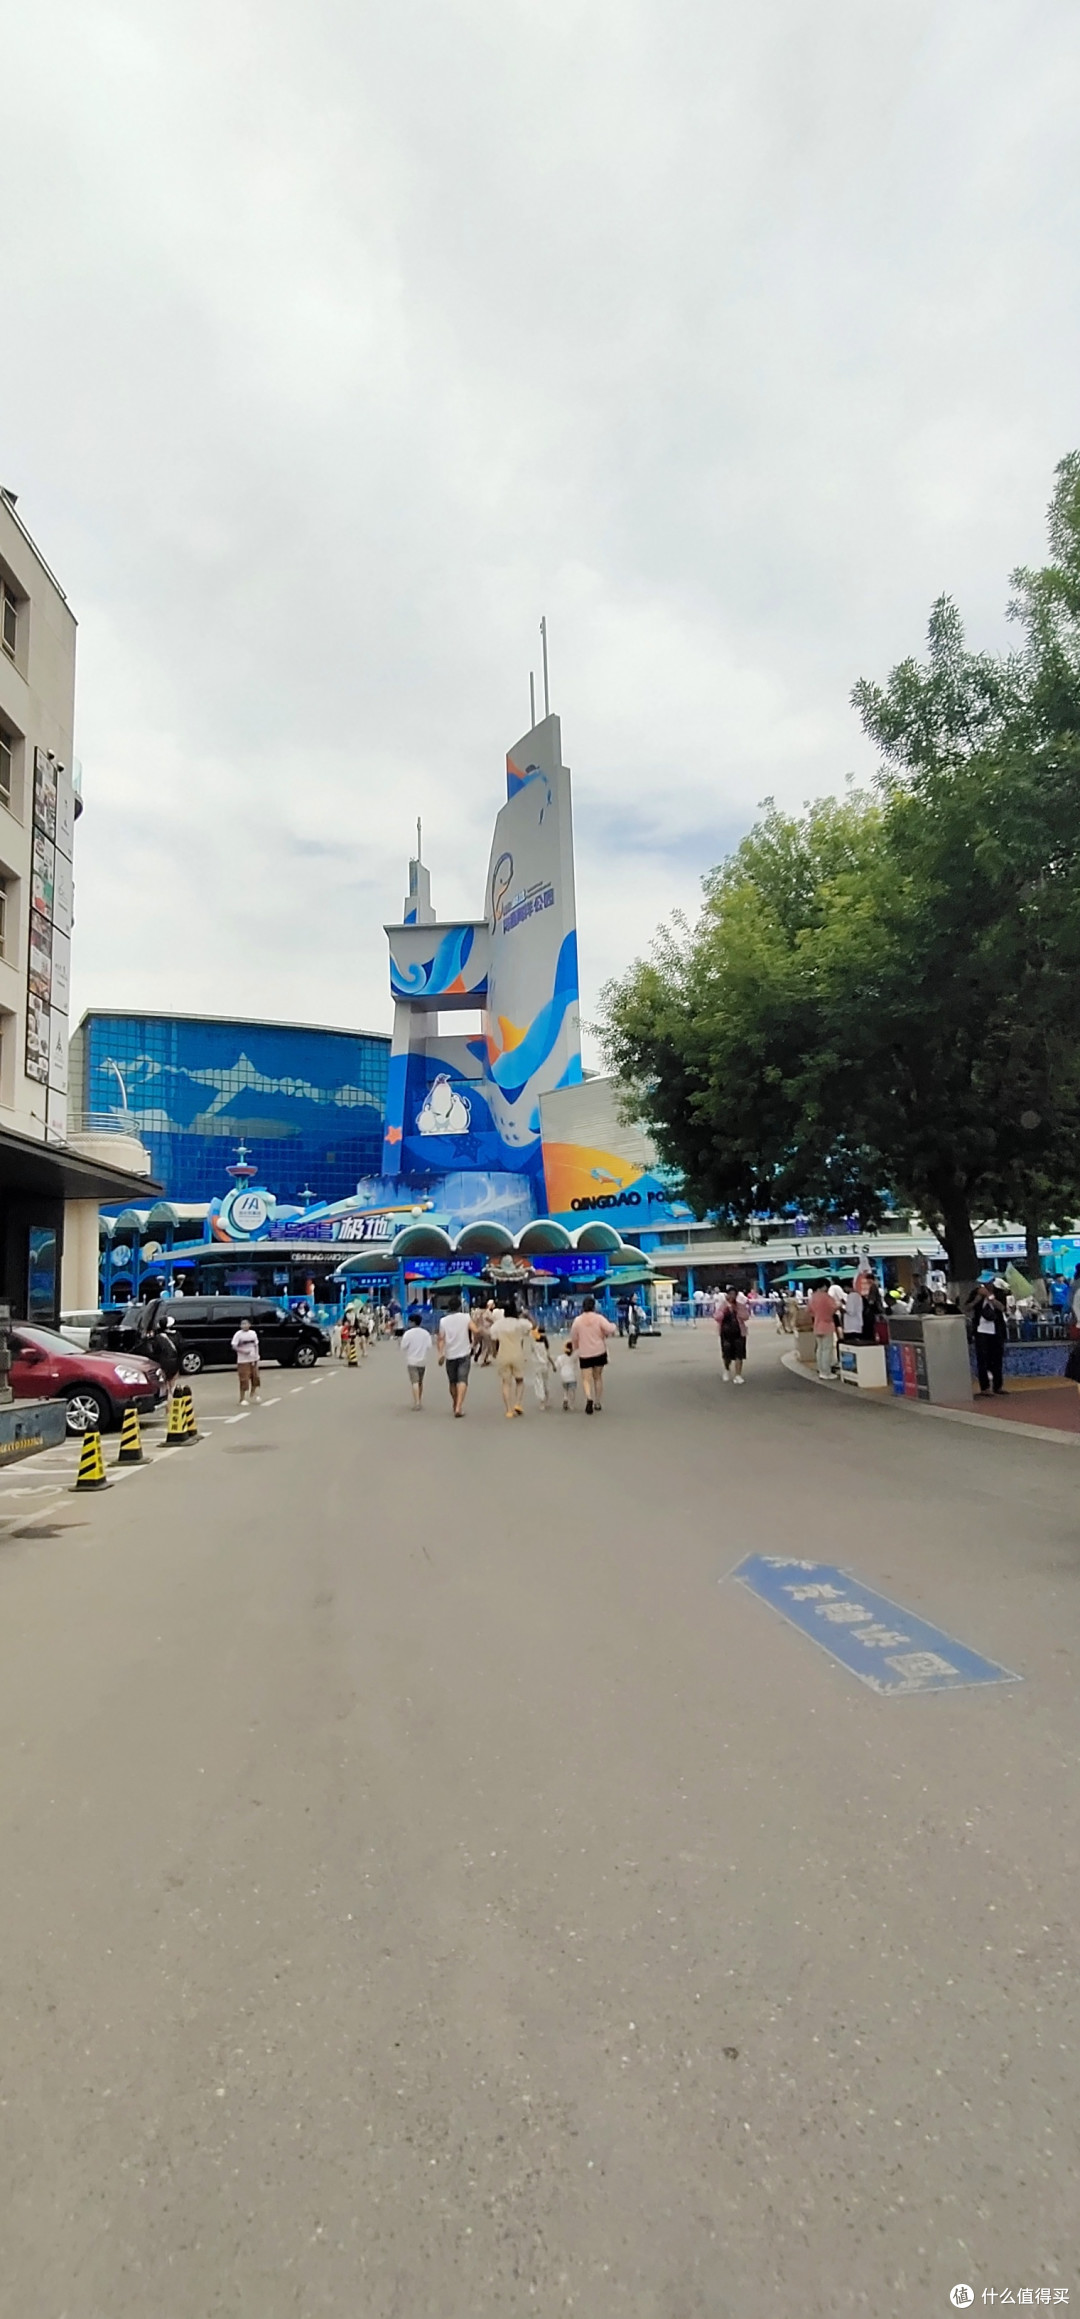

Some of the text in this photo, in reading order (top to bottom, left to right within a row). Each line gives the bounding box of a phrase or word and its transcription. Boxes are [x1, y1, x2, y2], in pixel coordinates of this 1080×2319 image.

[570, 1191, 665, 1211] QINGDAO PO
[791, 1241, 870, 1257] Tickets
